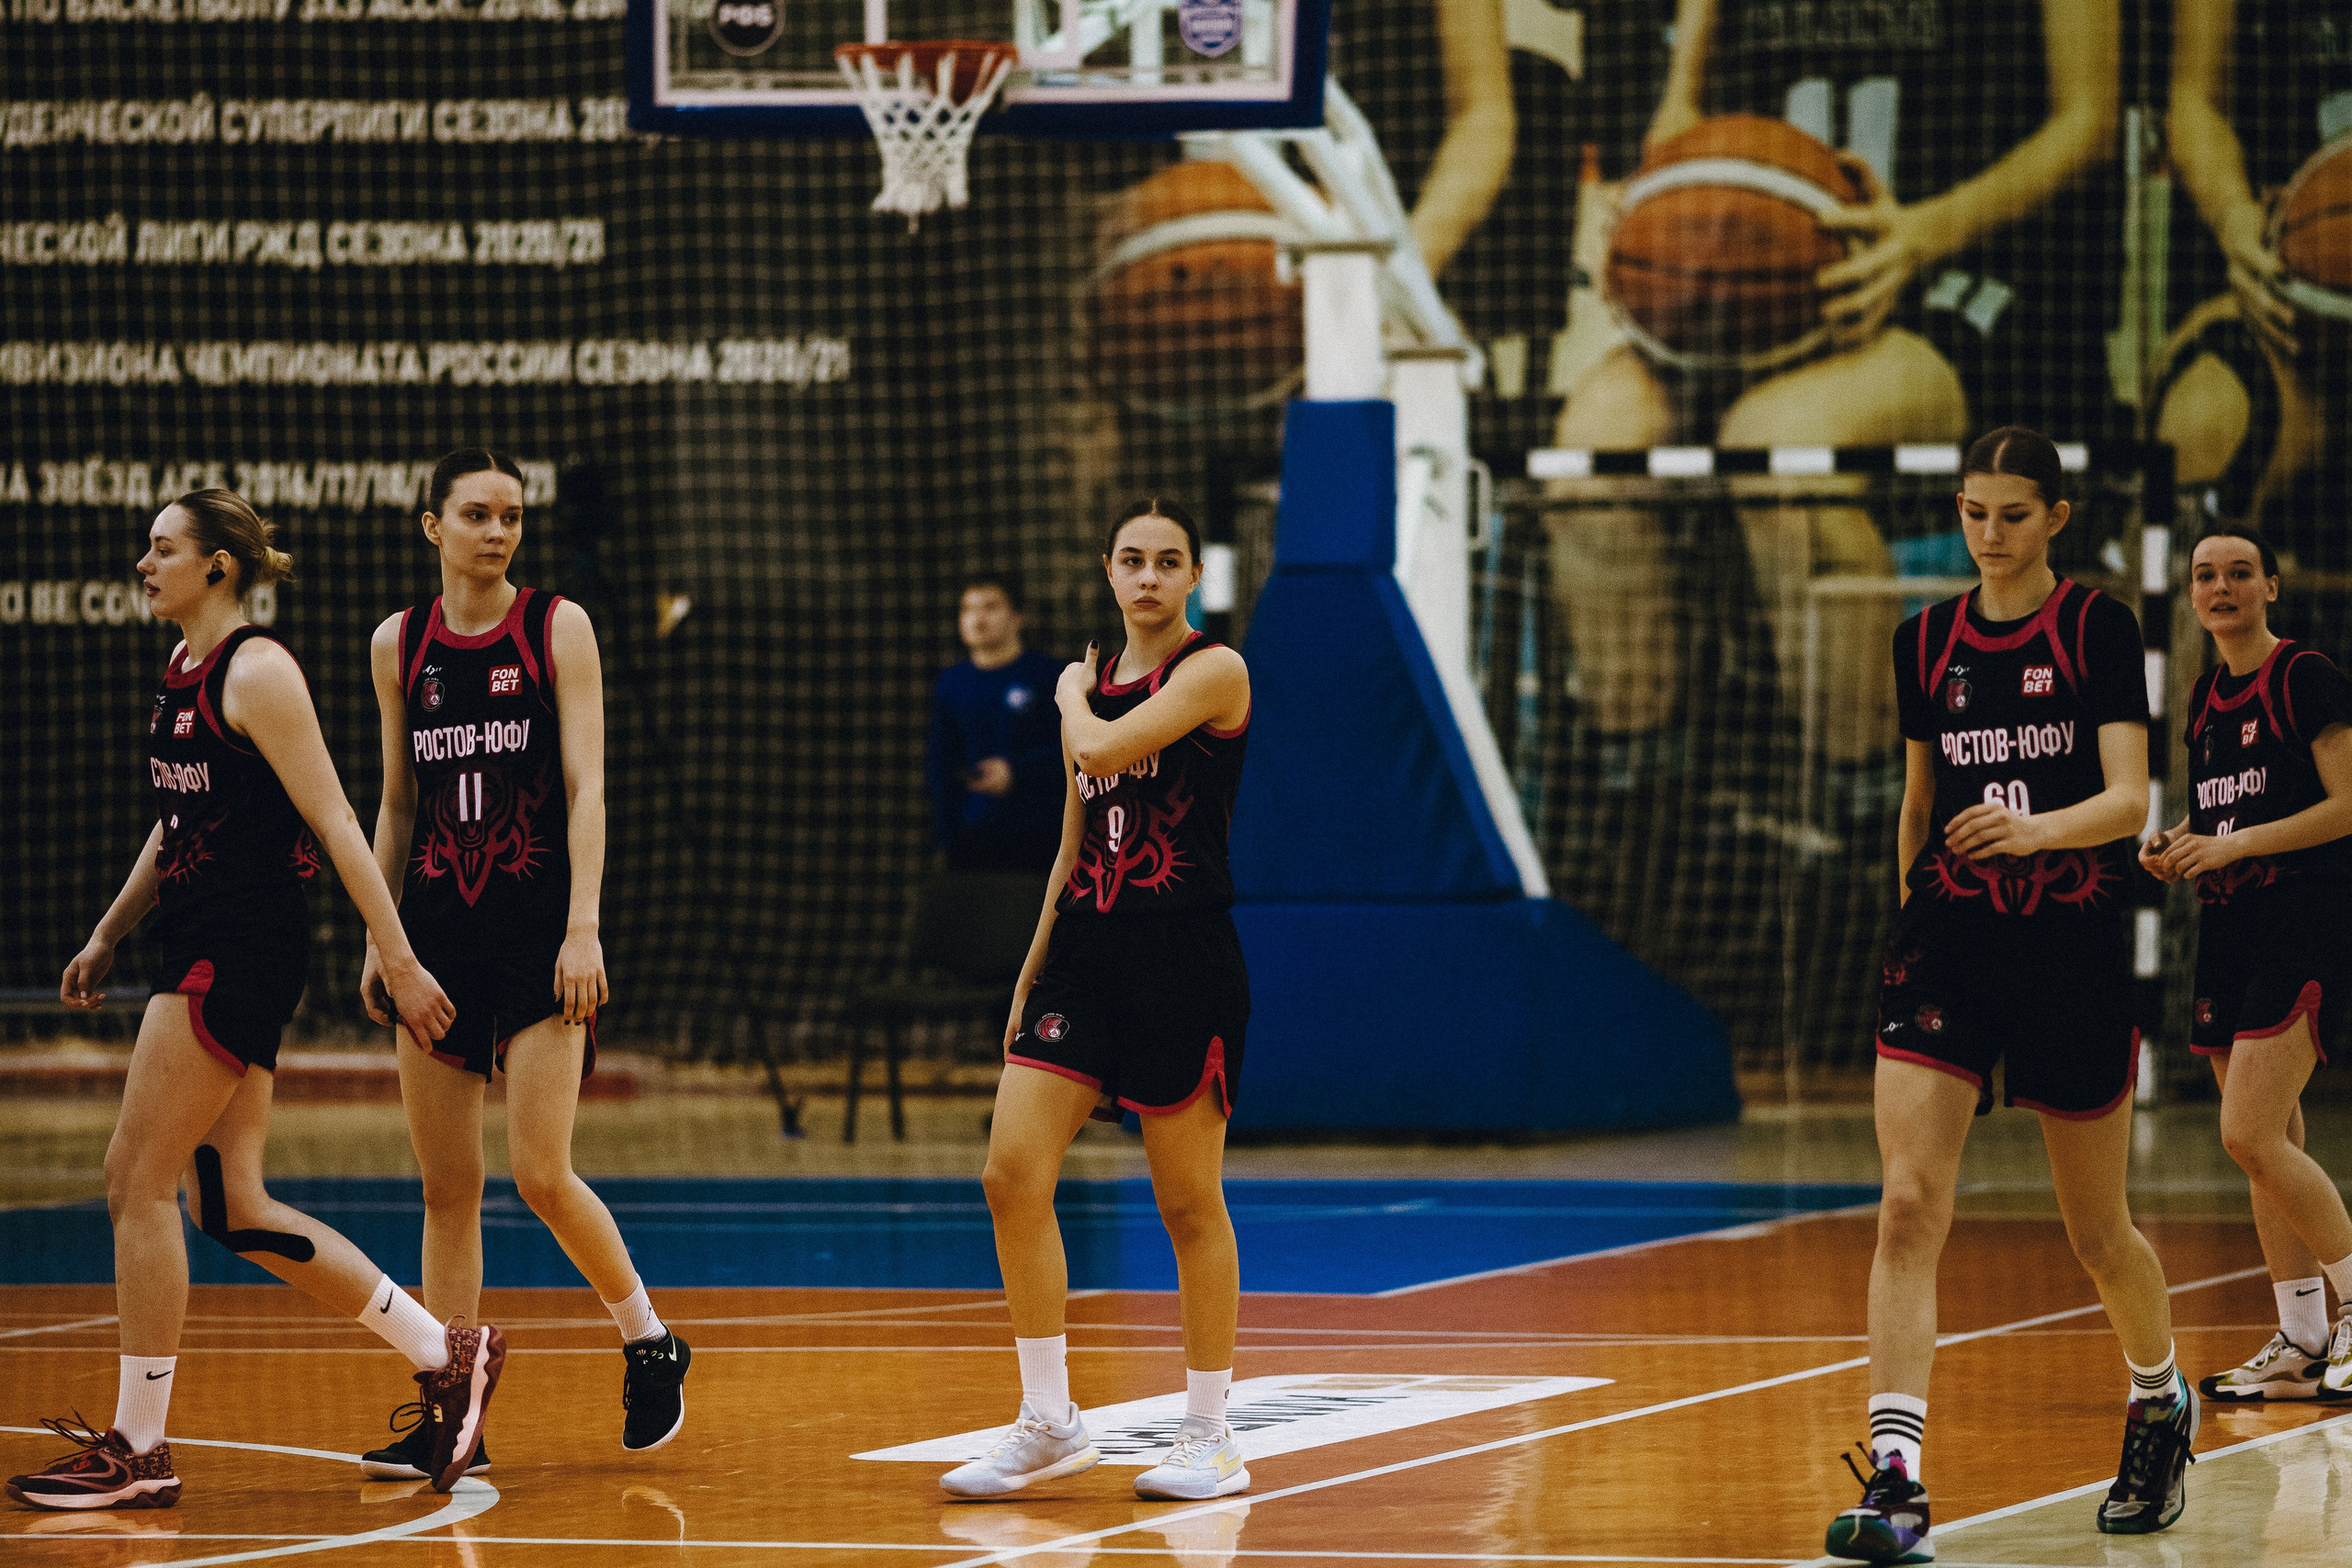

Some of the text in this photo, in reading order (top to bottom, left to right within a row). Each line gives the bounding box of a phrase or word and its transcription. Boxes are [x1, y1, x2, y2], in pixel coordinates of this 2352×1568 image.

[433, 99, 571, 143] СЕЗОНА
[136, 220, 229, 265] ЛИГИ
[233, 220, 321, 271] РЖД
[326, 220, 466, 265] СЕЗОНА
[186, 341, 424, 386] ЧЕМПИОНАТА
[428, 341, 571, 386] РОССИИ
[576, 339, 713, 385] СЕЗОНА
[38, 454, 153, 511] ЗВЁЗД
[491, 668, 519, 681] FON
[491, 680, 519, 693] BET
[2023, 668, 2052, 681] FON
[2023, 680, 2052, 694] BET
[174, 723, 193, 734] BET
[413, 718, 530, 762] РОСТОВ-ЮФУ
[1940, 720, 2075, 766] РОСТОВ-ЮФУ
[459, 772, 482, 821] 11
[1107, 806, 1125, 852] 9
